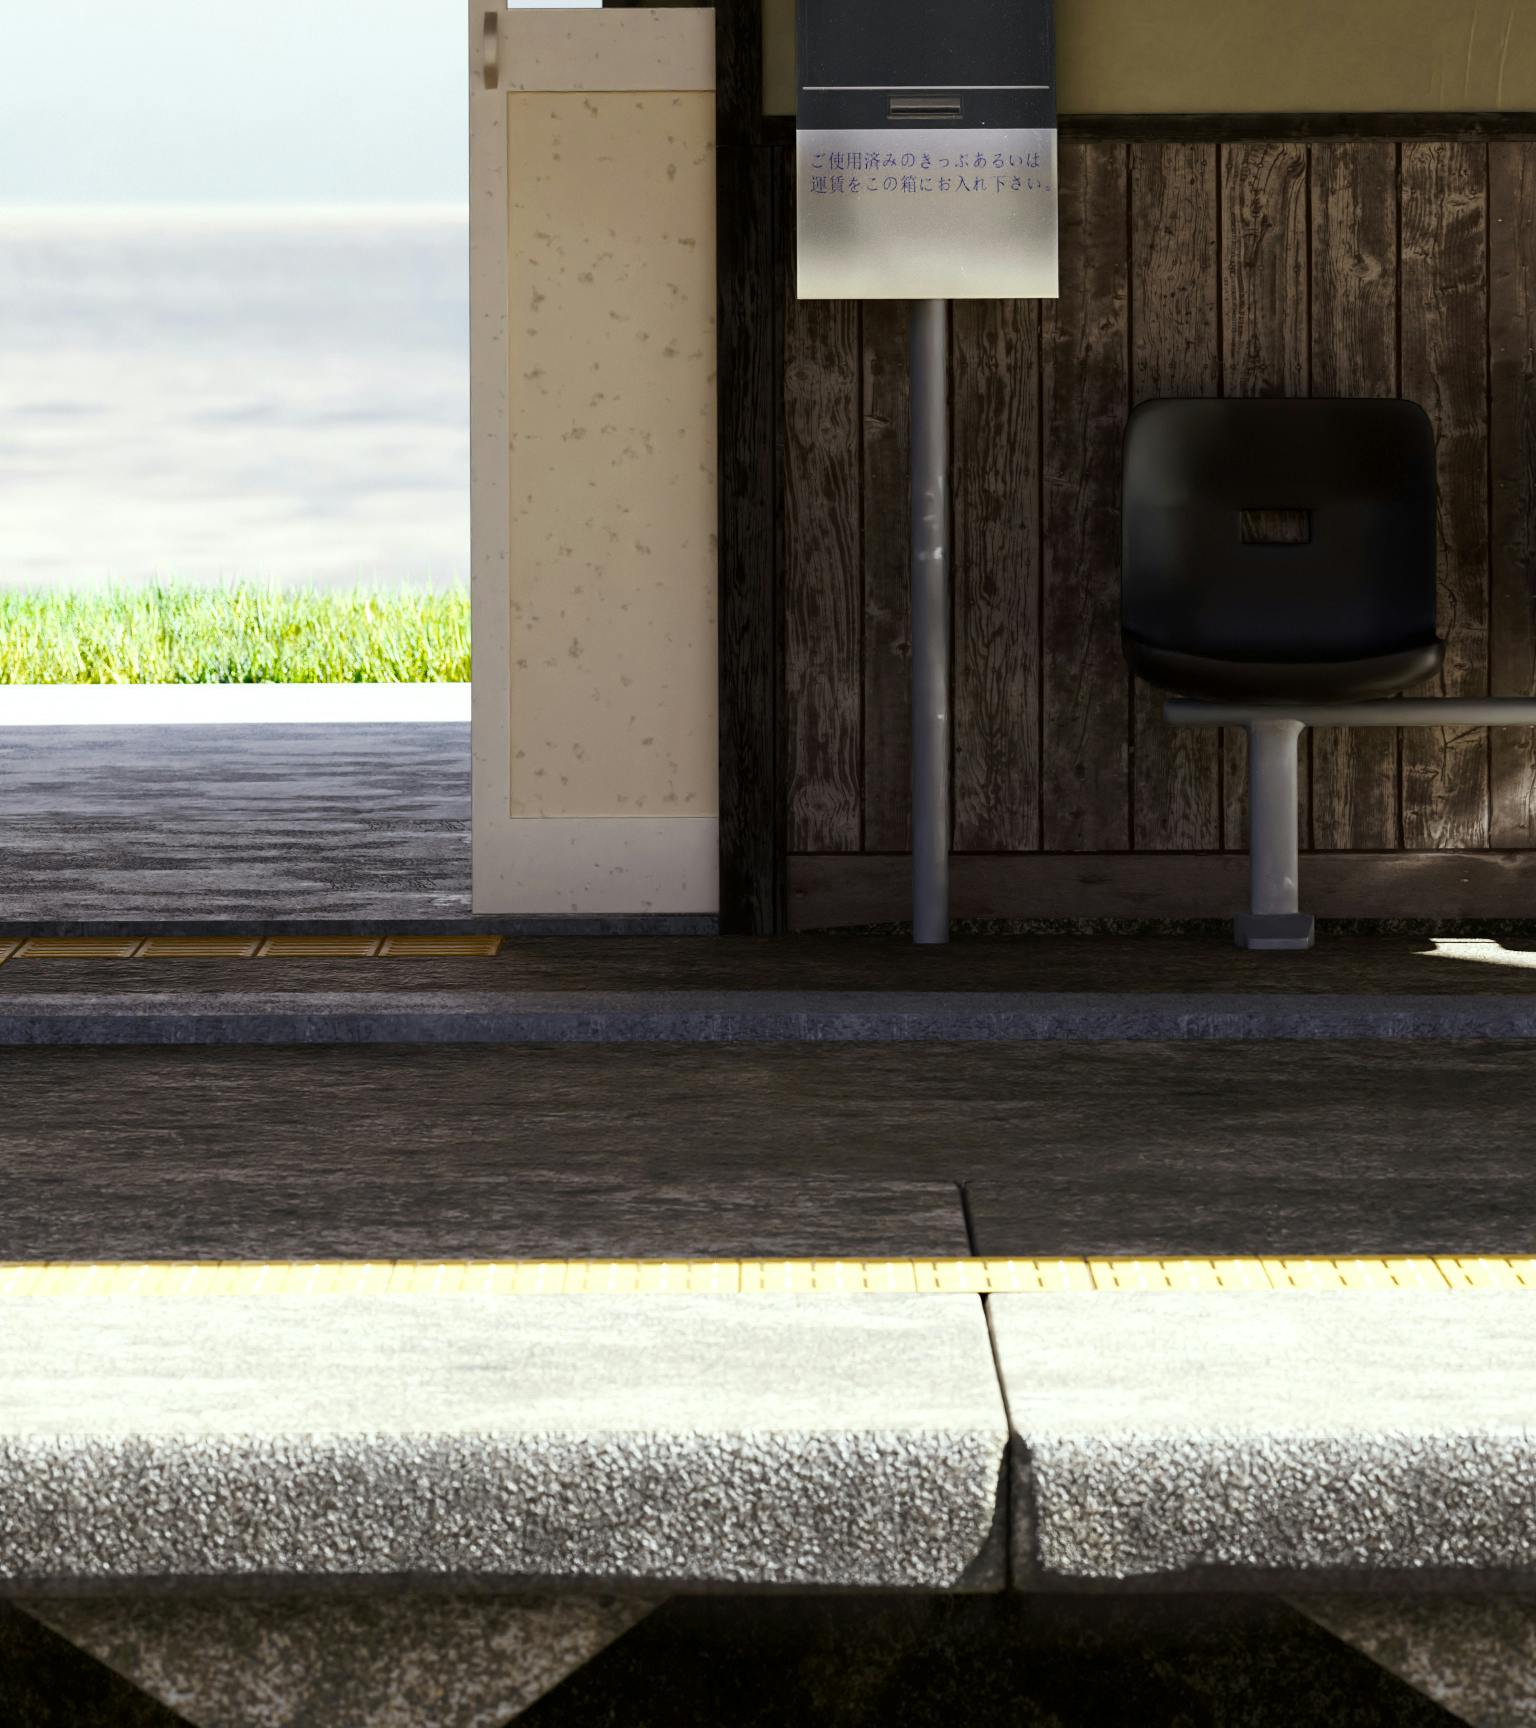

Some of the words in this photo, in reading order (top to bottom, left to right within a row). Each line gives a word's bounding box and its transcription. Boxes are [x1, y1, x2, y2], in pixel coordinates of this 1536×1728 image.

[810, 149, 1041, 171] ご使用済みのきっぷあるいは
